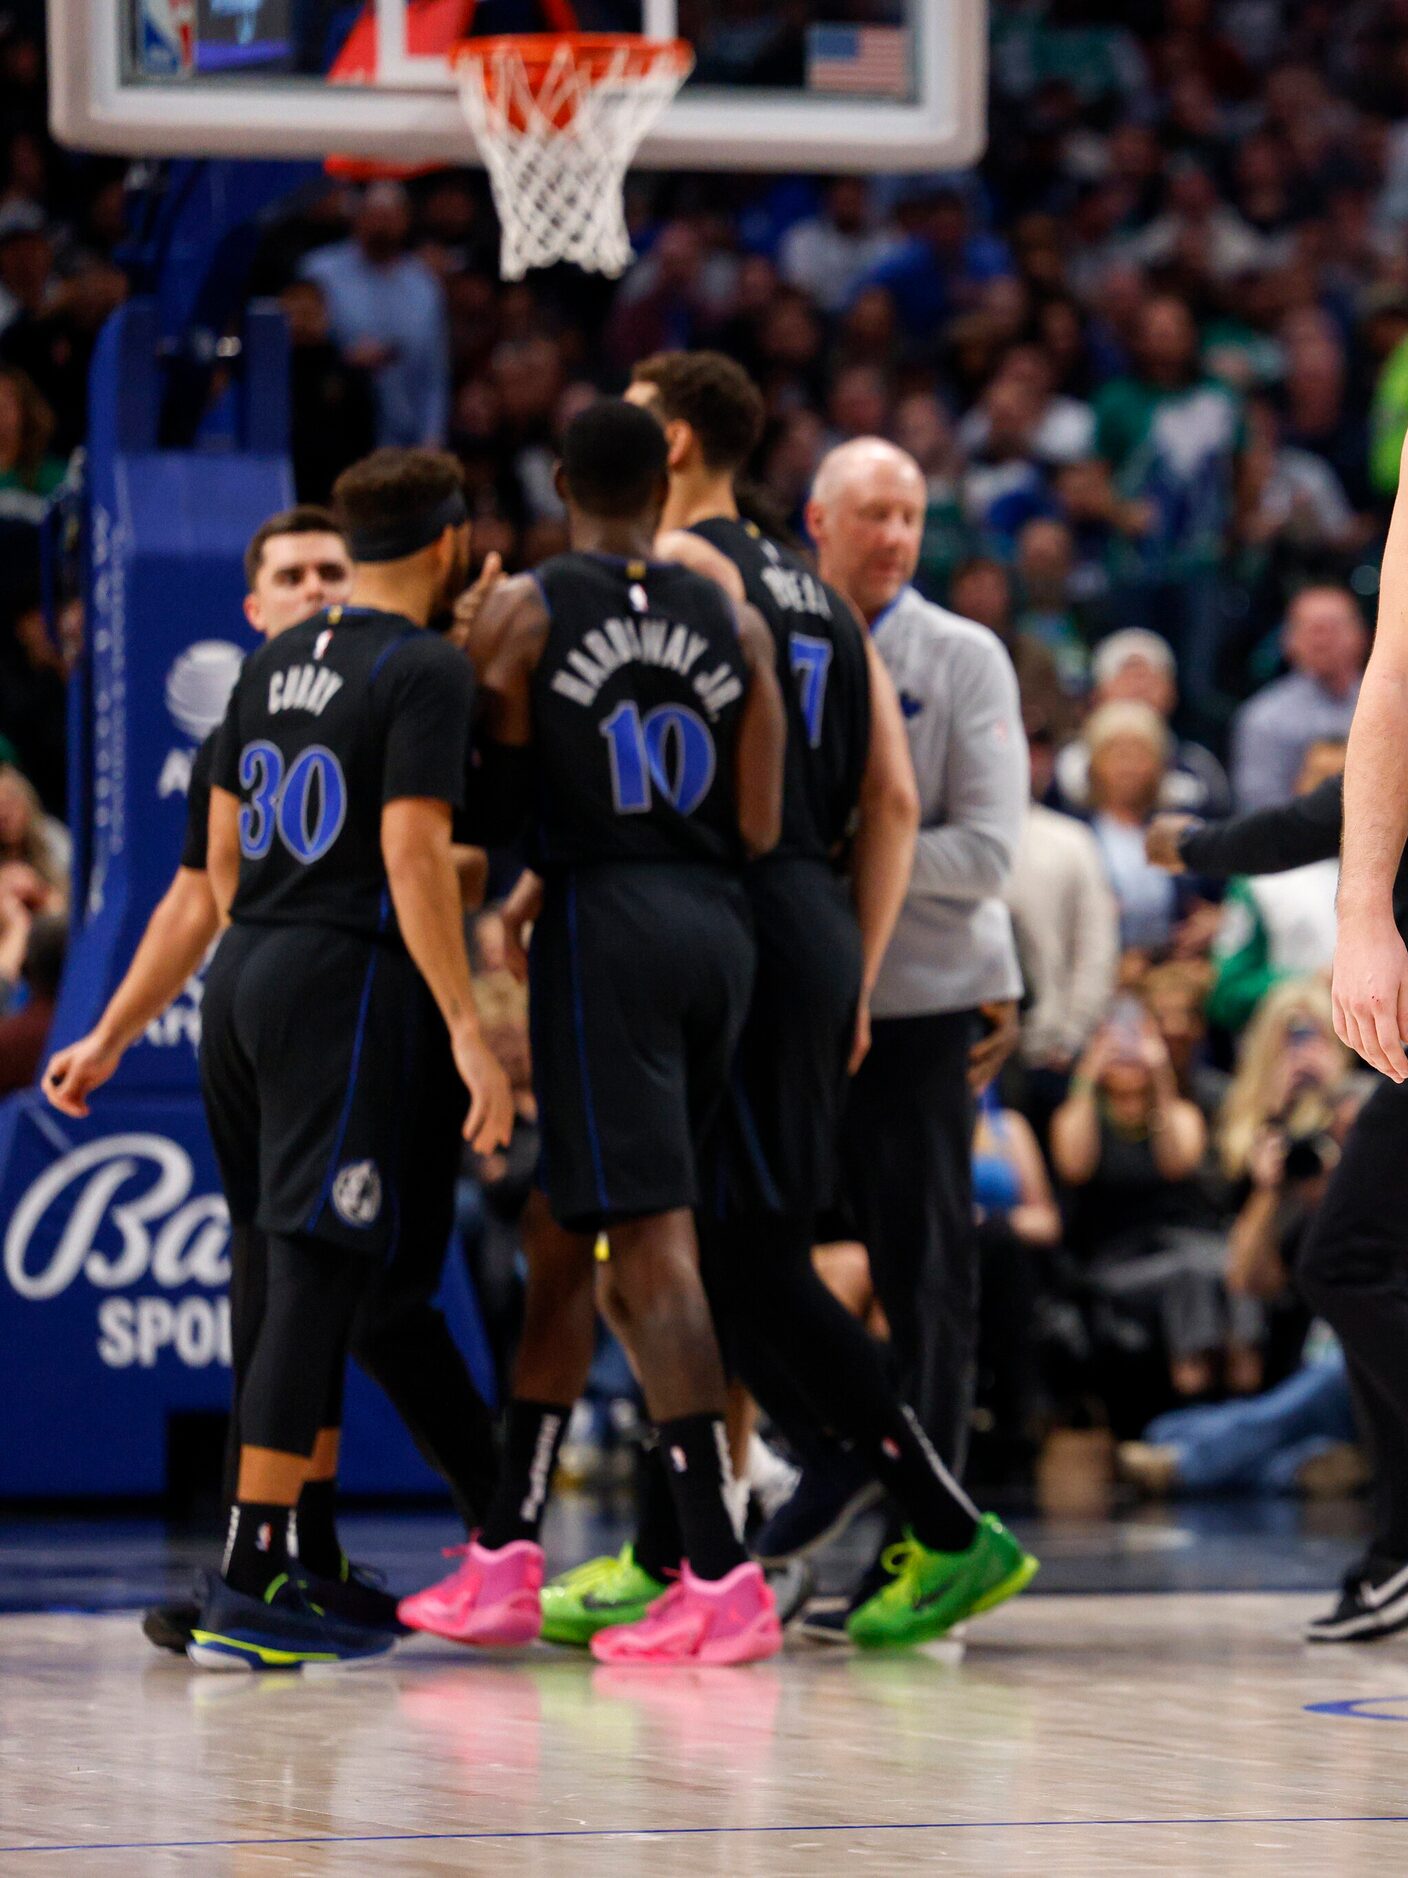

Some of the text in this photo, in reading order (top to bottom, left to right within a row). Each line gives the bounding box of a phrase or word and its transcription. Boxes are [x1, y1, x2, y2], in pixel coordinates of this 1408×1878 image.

[788, 631, 834, 749] 7
[238, 739, 348, 865] 30
[598, 698, 717, 817] 10
